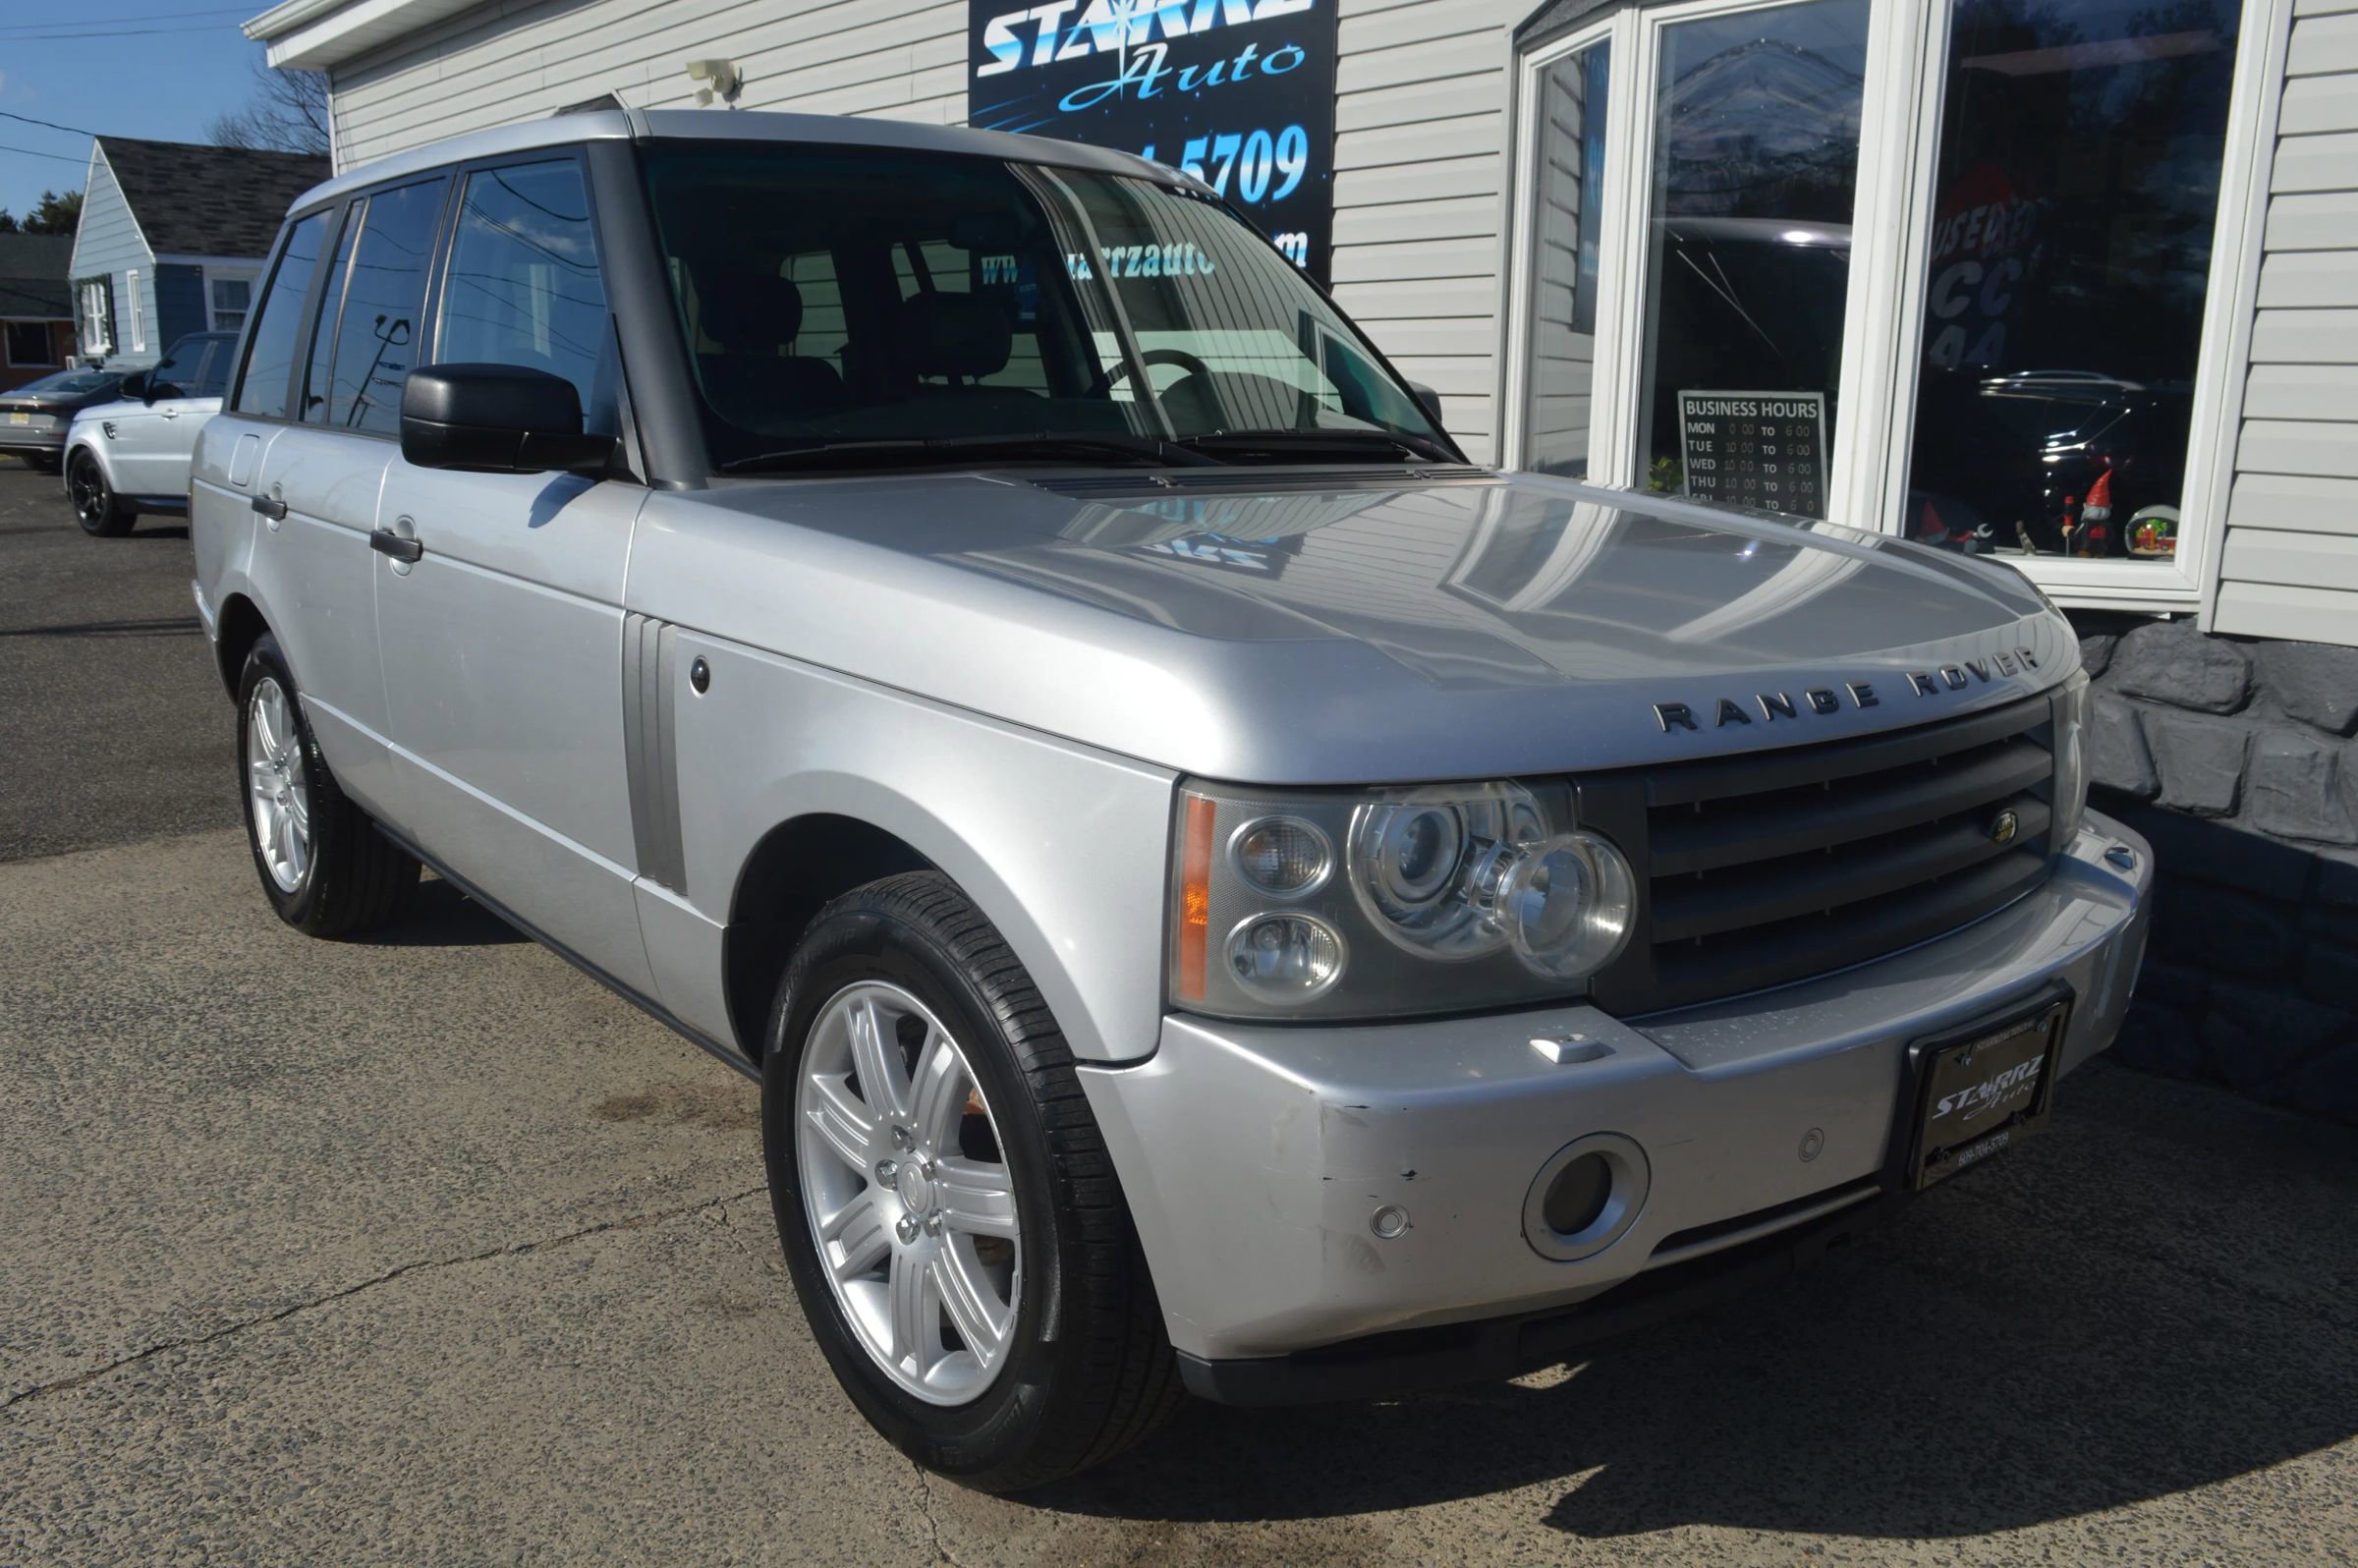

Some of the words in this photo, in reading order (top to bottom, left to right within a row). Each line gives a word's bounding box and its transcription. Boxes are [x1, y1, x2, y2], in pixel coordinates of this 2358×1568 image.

[977, 0, 1313, 78] STAR
[1058, 42, 1306, 112] Auto
[1686, 401, 1758, 417] BUSINESS
[1762, 402, 1818, 419] HOURS
[1687, 422, 1715, 434] MON
[1761, 426, 1775, 436] TO
[1688, 440, 1713, 452] TUE
[1762, 445, 1776, 455] TO
[1689, 458, 1716, 470] WED
[1763, 464, 1777, 474] TO
[1690, 476, 1716, 487] THU
[1764, 482, 1778, 492] TO
[1765, 500, 1779, 510] TO
[1653, 680, 1880, 732] RANGE
[1904, 645, 2040, 698] ROVER
[1931, 1053, 2045, 1120] STARRZ
